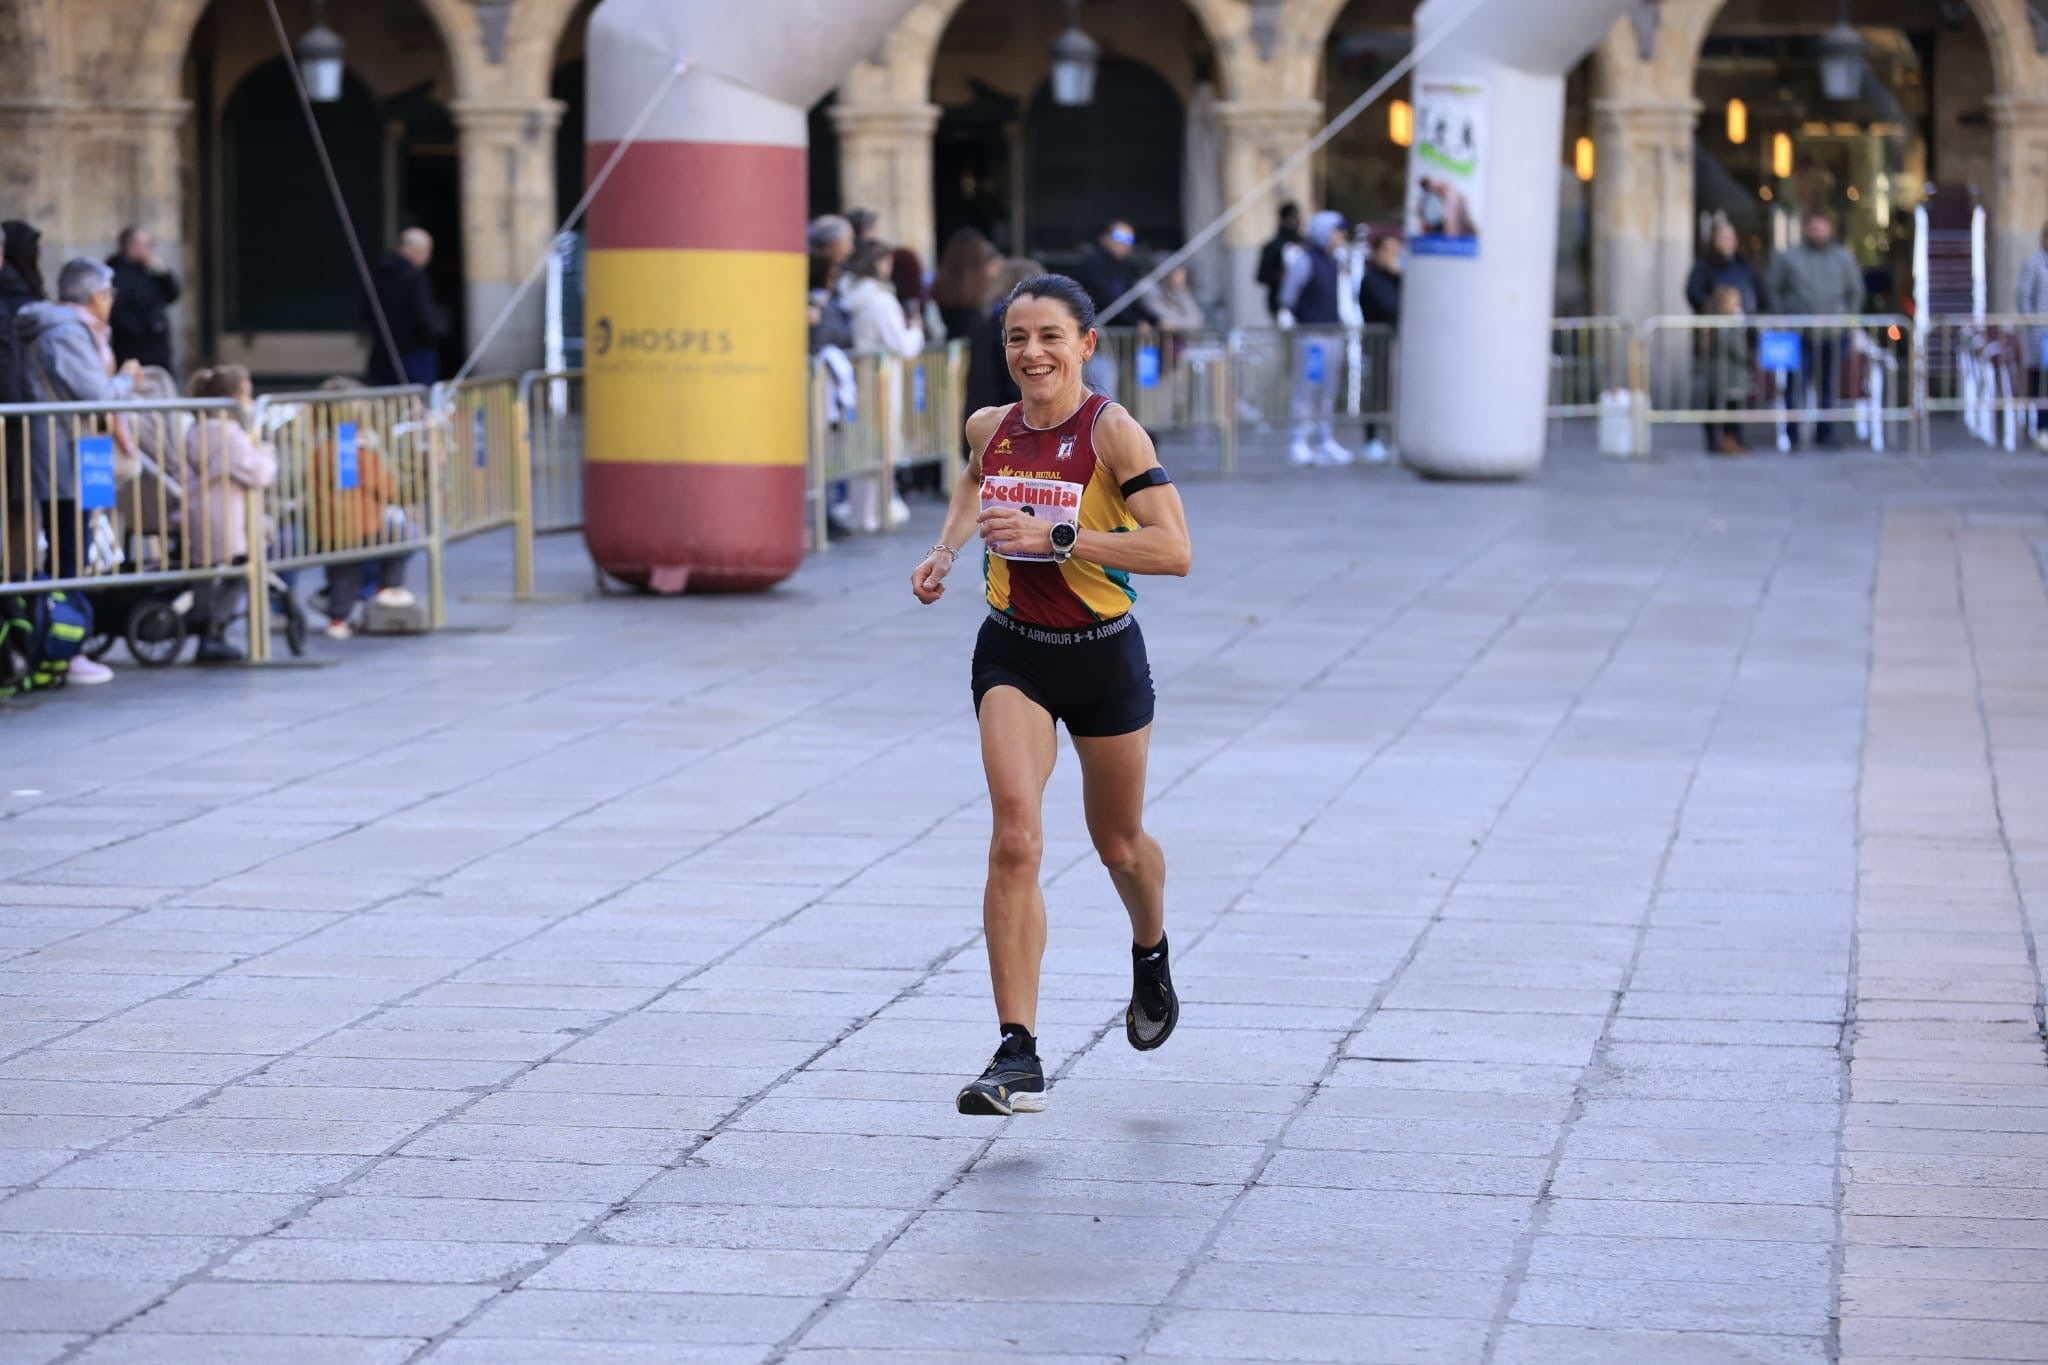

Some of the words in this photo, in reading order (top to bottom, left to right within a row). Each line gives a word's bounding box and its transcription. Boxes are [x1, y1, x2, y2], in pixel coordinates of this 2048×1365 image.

[618, 327, 733, 354] HOSPES
[1014, 470, 1034, 478] CAJA
[1035, 471, 1062, 480] RURAL
[981, 481, 1078, 507] bedunia
[1027, 629, 1072, 645] ARMOUR
